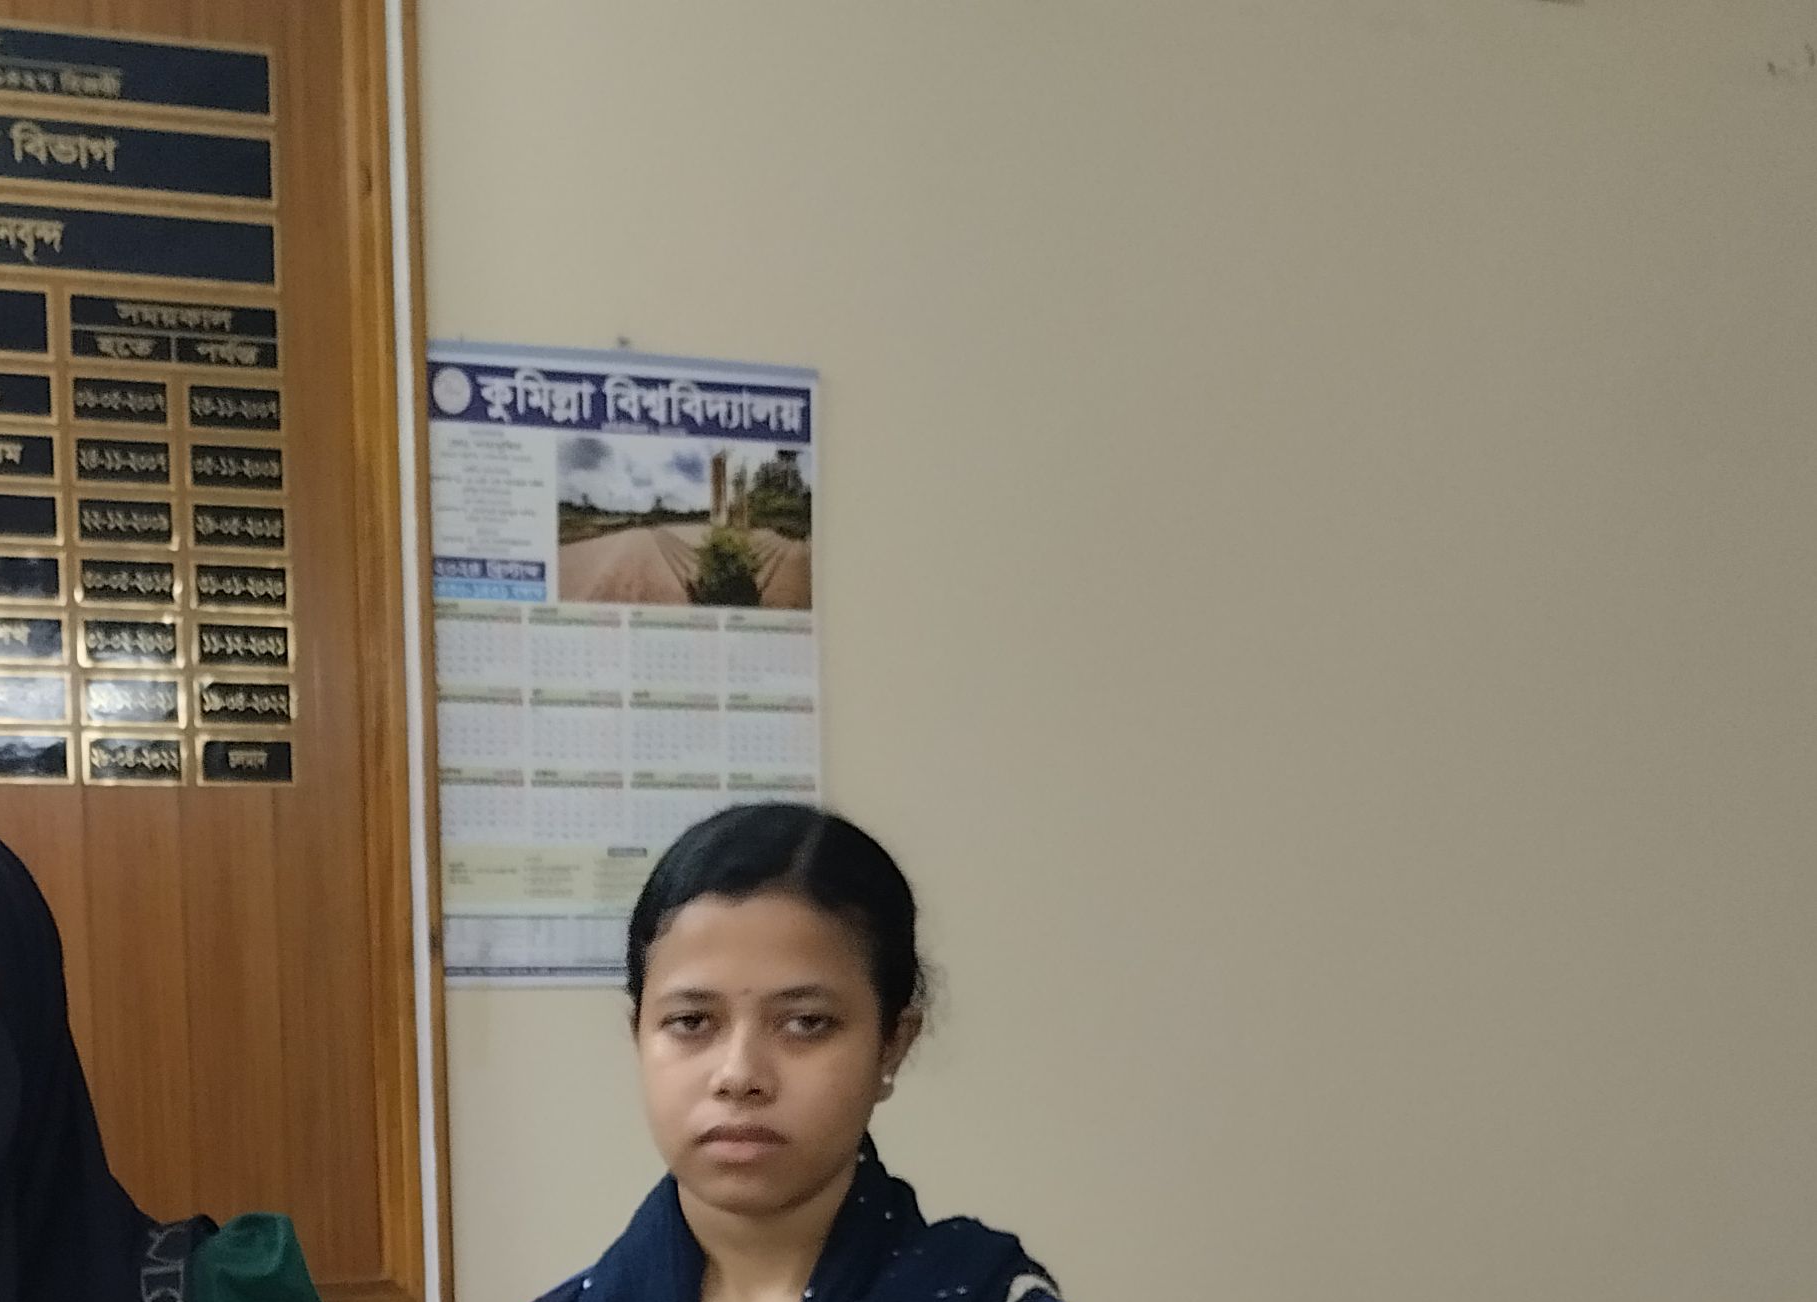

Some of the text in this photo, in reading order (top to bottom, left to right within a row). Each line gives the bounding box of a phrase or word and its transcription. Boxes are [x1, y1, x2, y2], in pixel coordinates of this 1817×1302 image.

[11, 120, 116, 172] বিভাগ
[95, 335, 154, 359] হতে
[477, 366, 806, 435] কুমিল্লা বিশ্ববিদ্যালয়
